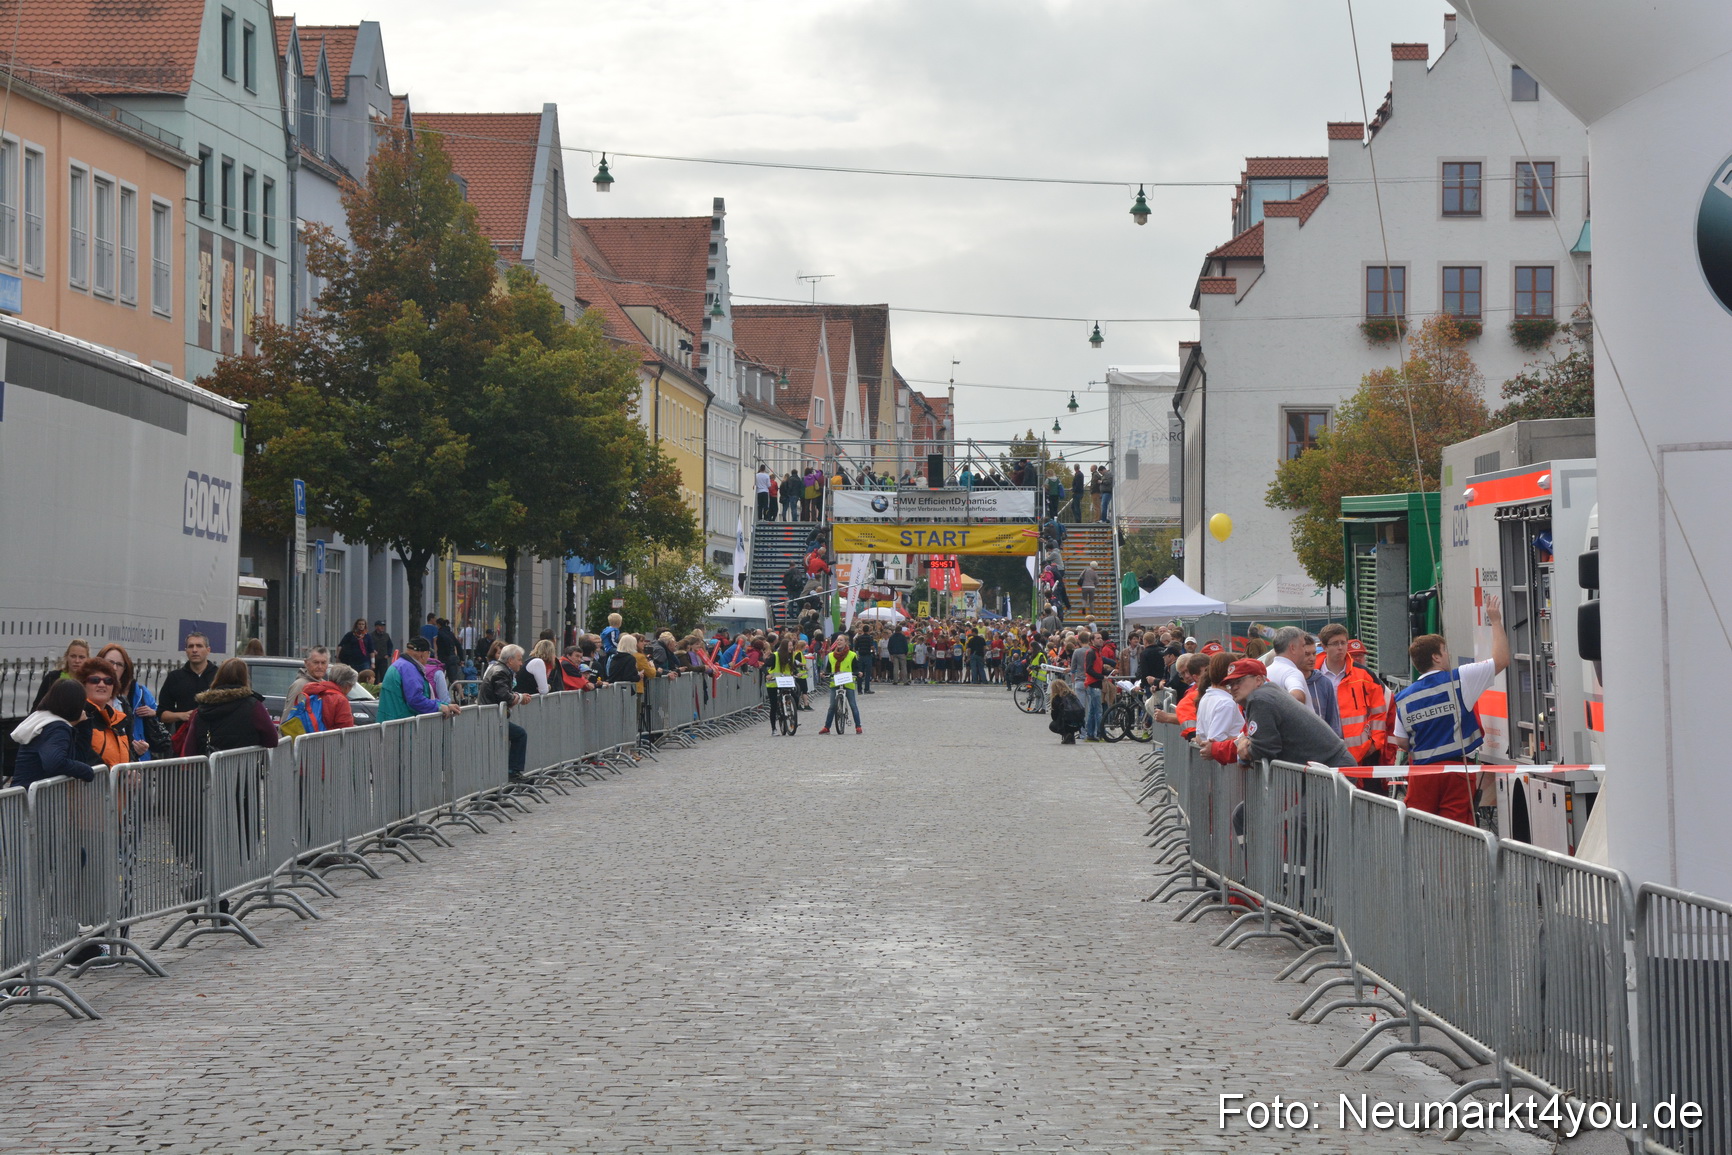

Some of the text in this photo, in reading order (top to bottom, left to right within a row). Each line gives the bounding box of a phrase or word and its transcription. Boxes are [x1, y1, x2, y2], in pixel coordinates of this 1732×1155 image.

[184, 471, 231, 542] BOCK
[893, 497, 917, 505] BMW
[919, 497, 997, 506] EfficientDynamics
[900, 530, 970, 547] START
[920, 606, 927, 614] A
[1406, 703, 1456, 724] SEG-LEITER
